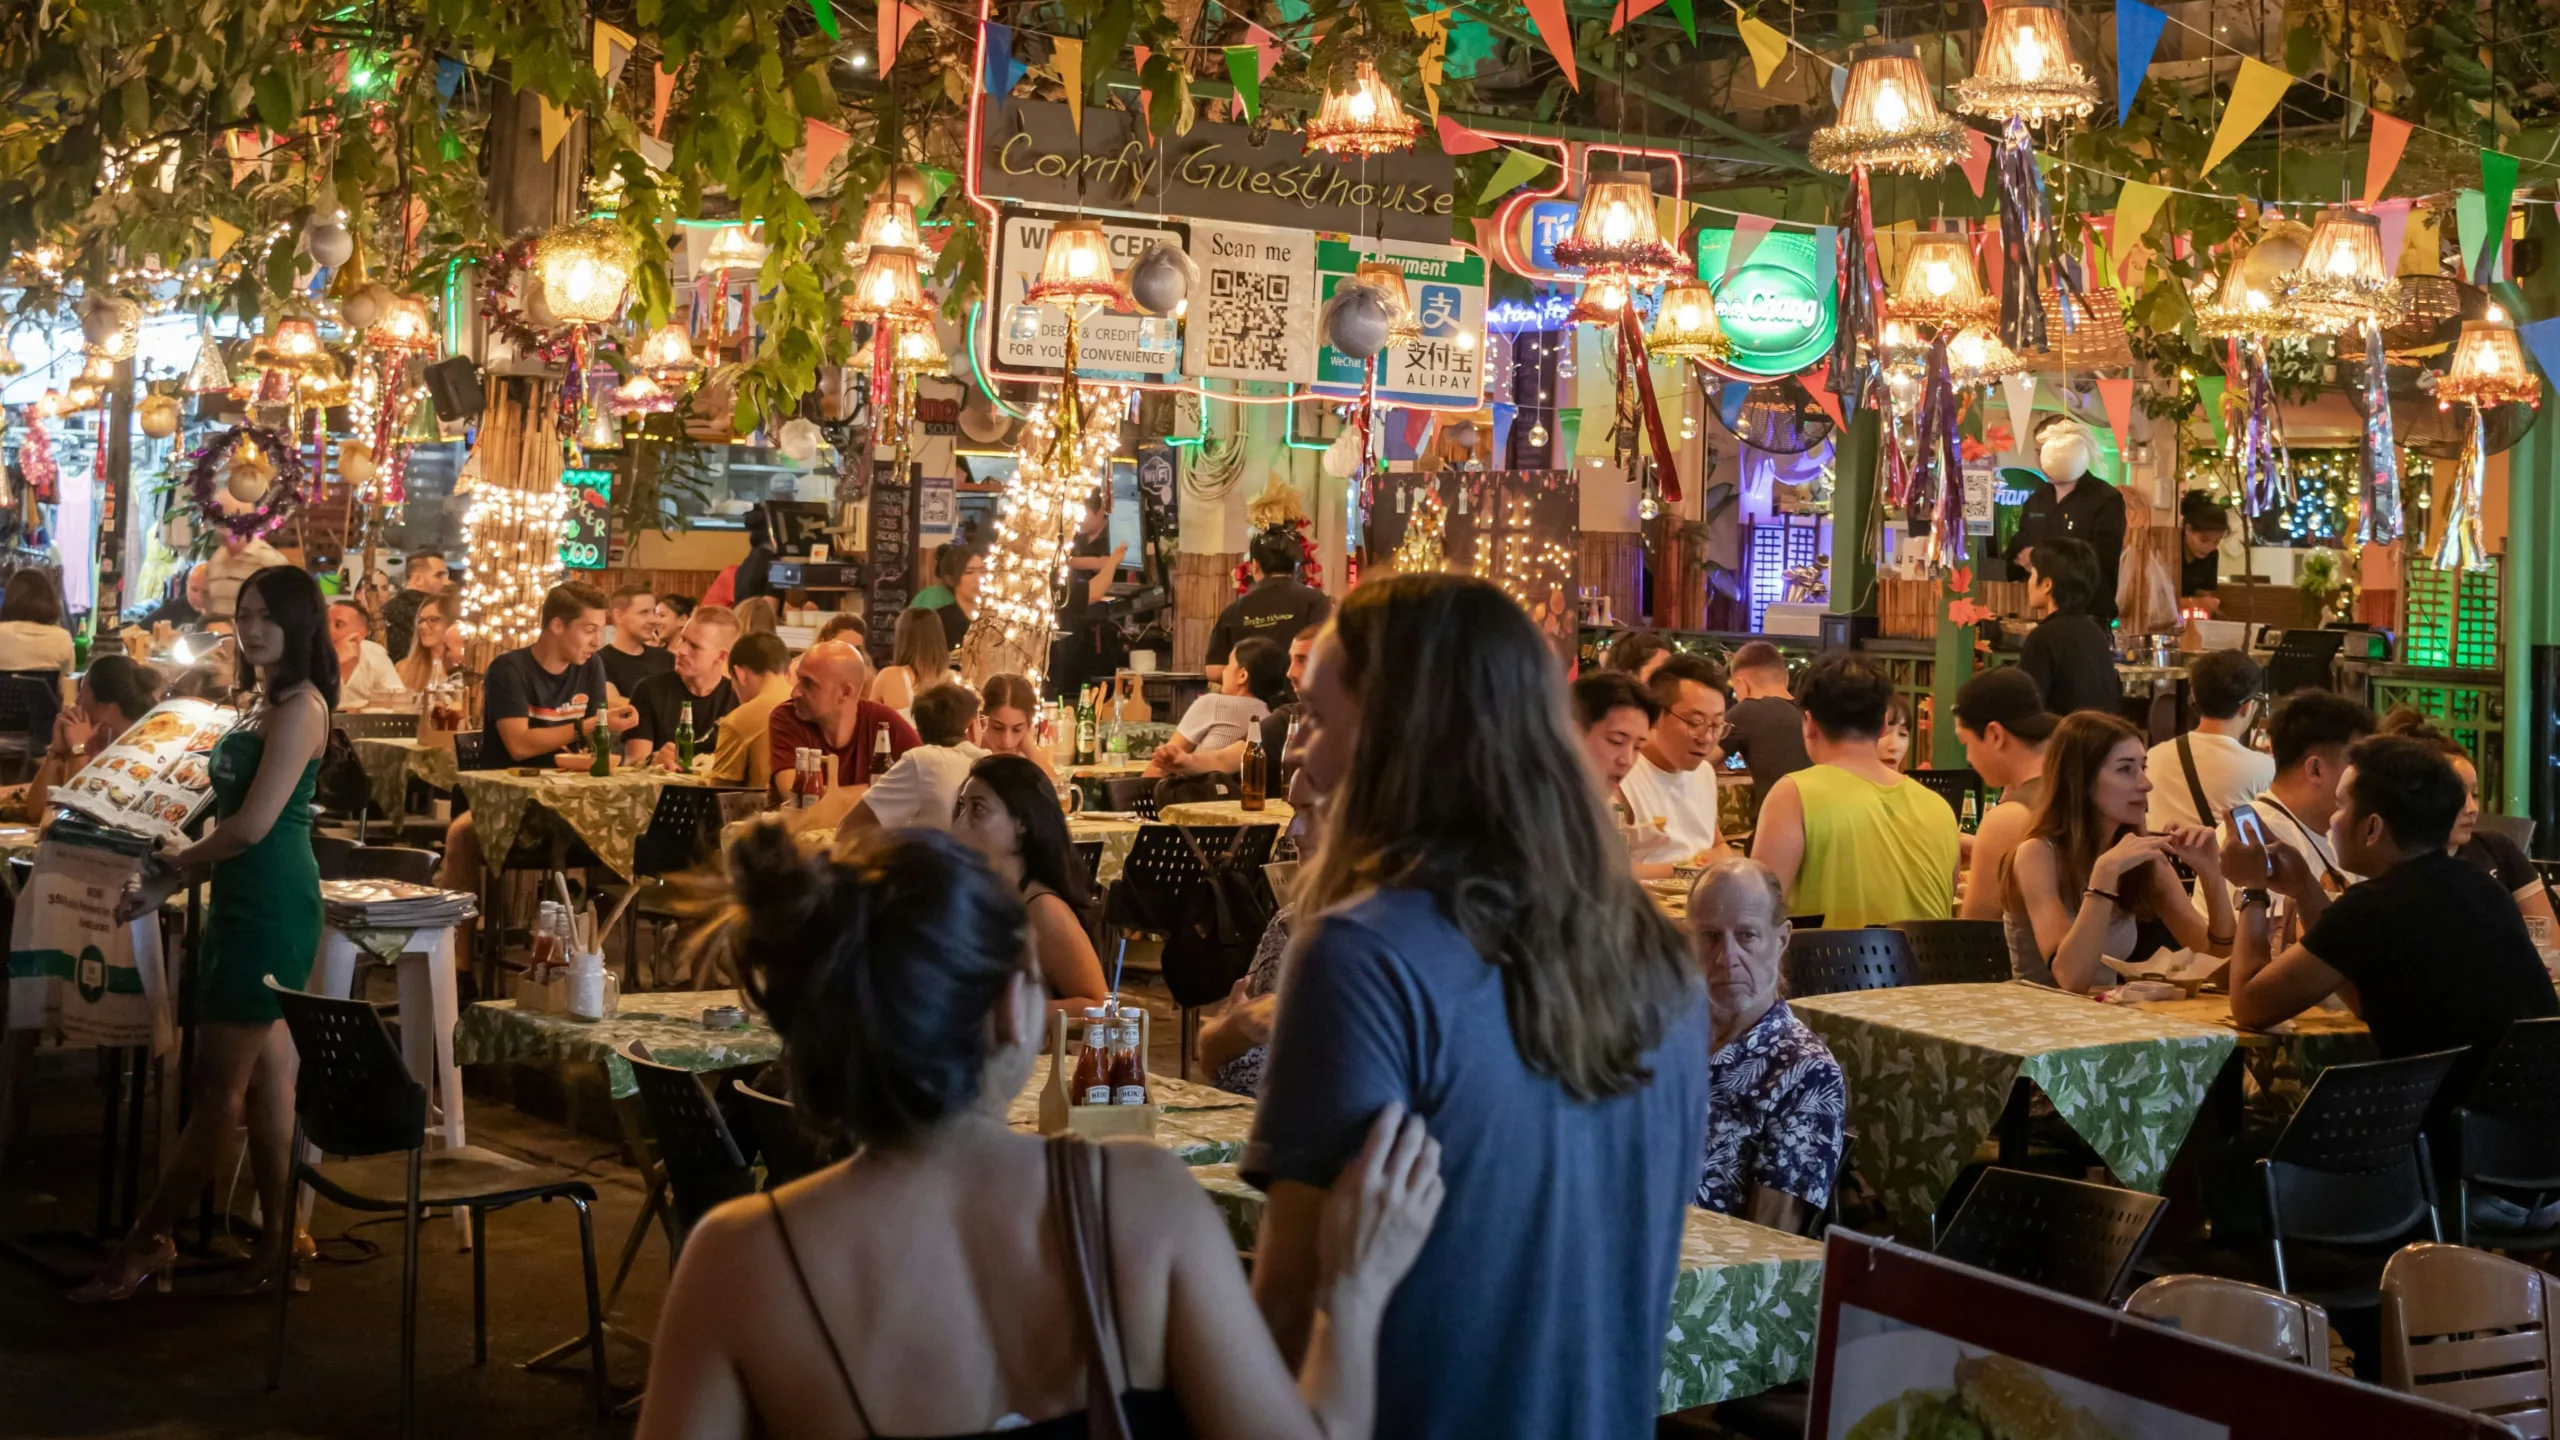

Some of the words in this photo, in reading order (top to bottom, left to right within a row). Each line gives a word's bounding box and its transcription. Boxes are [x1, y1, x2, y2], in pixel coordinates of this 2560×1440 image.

[1001, 132, 1157, 202] Comfy
[1182, 144, 1454, 215] Guesthouse
[1212, 232, 1256, 258] Scan
[1265, 245, 1291, 262] me
[1041, 324, 1067, 337] DEB
[1082, 327, 1090, 339] &
[1095, 328, 1137, 341] CREDIT
[1009, 343, 1033, 356] FOR
[1040, 345, 1066, 358] YOU
[1081, 348, 1165, 365] CONVENIENCE
[1330, 356, 1361, 368] WeChat
[1406, 372, 1471, 389] ALIPAY
[926, 423, 959, 435] SOJU
[570, 487, 606, 537] BEER
